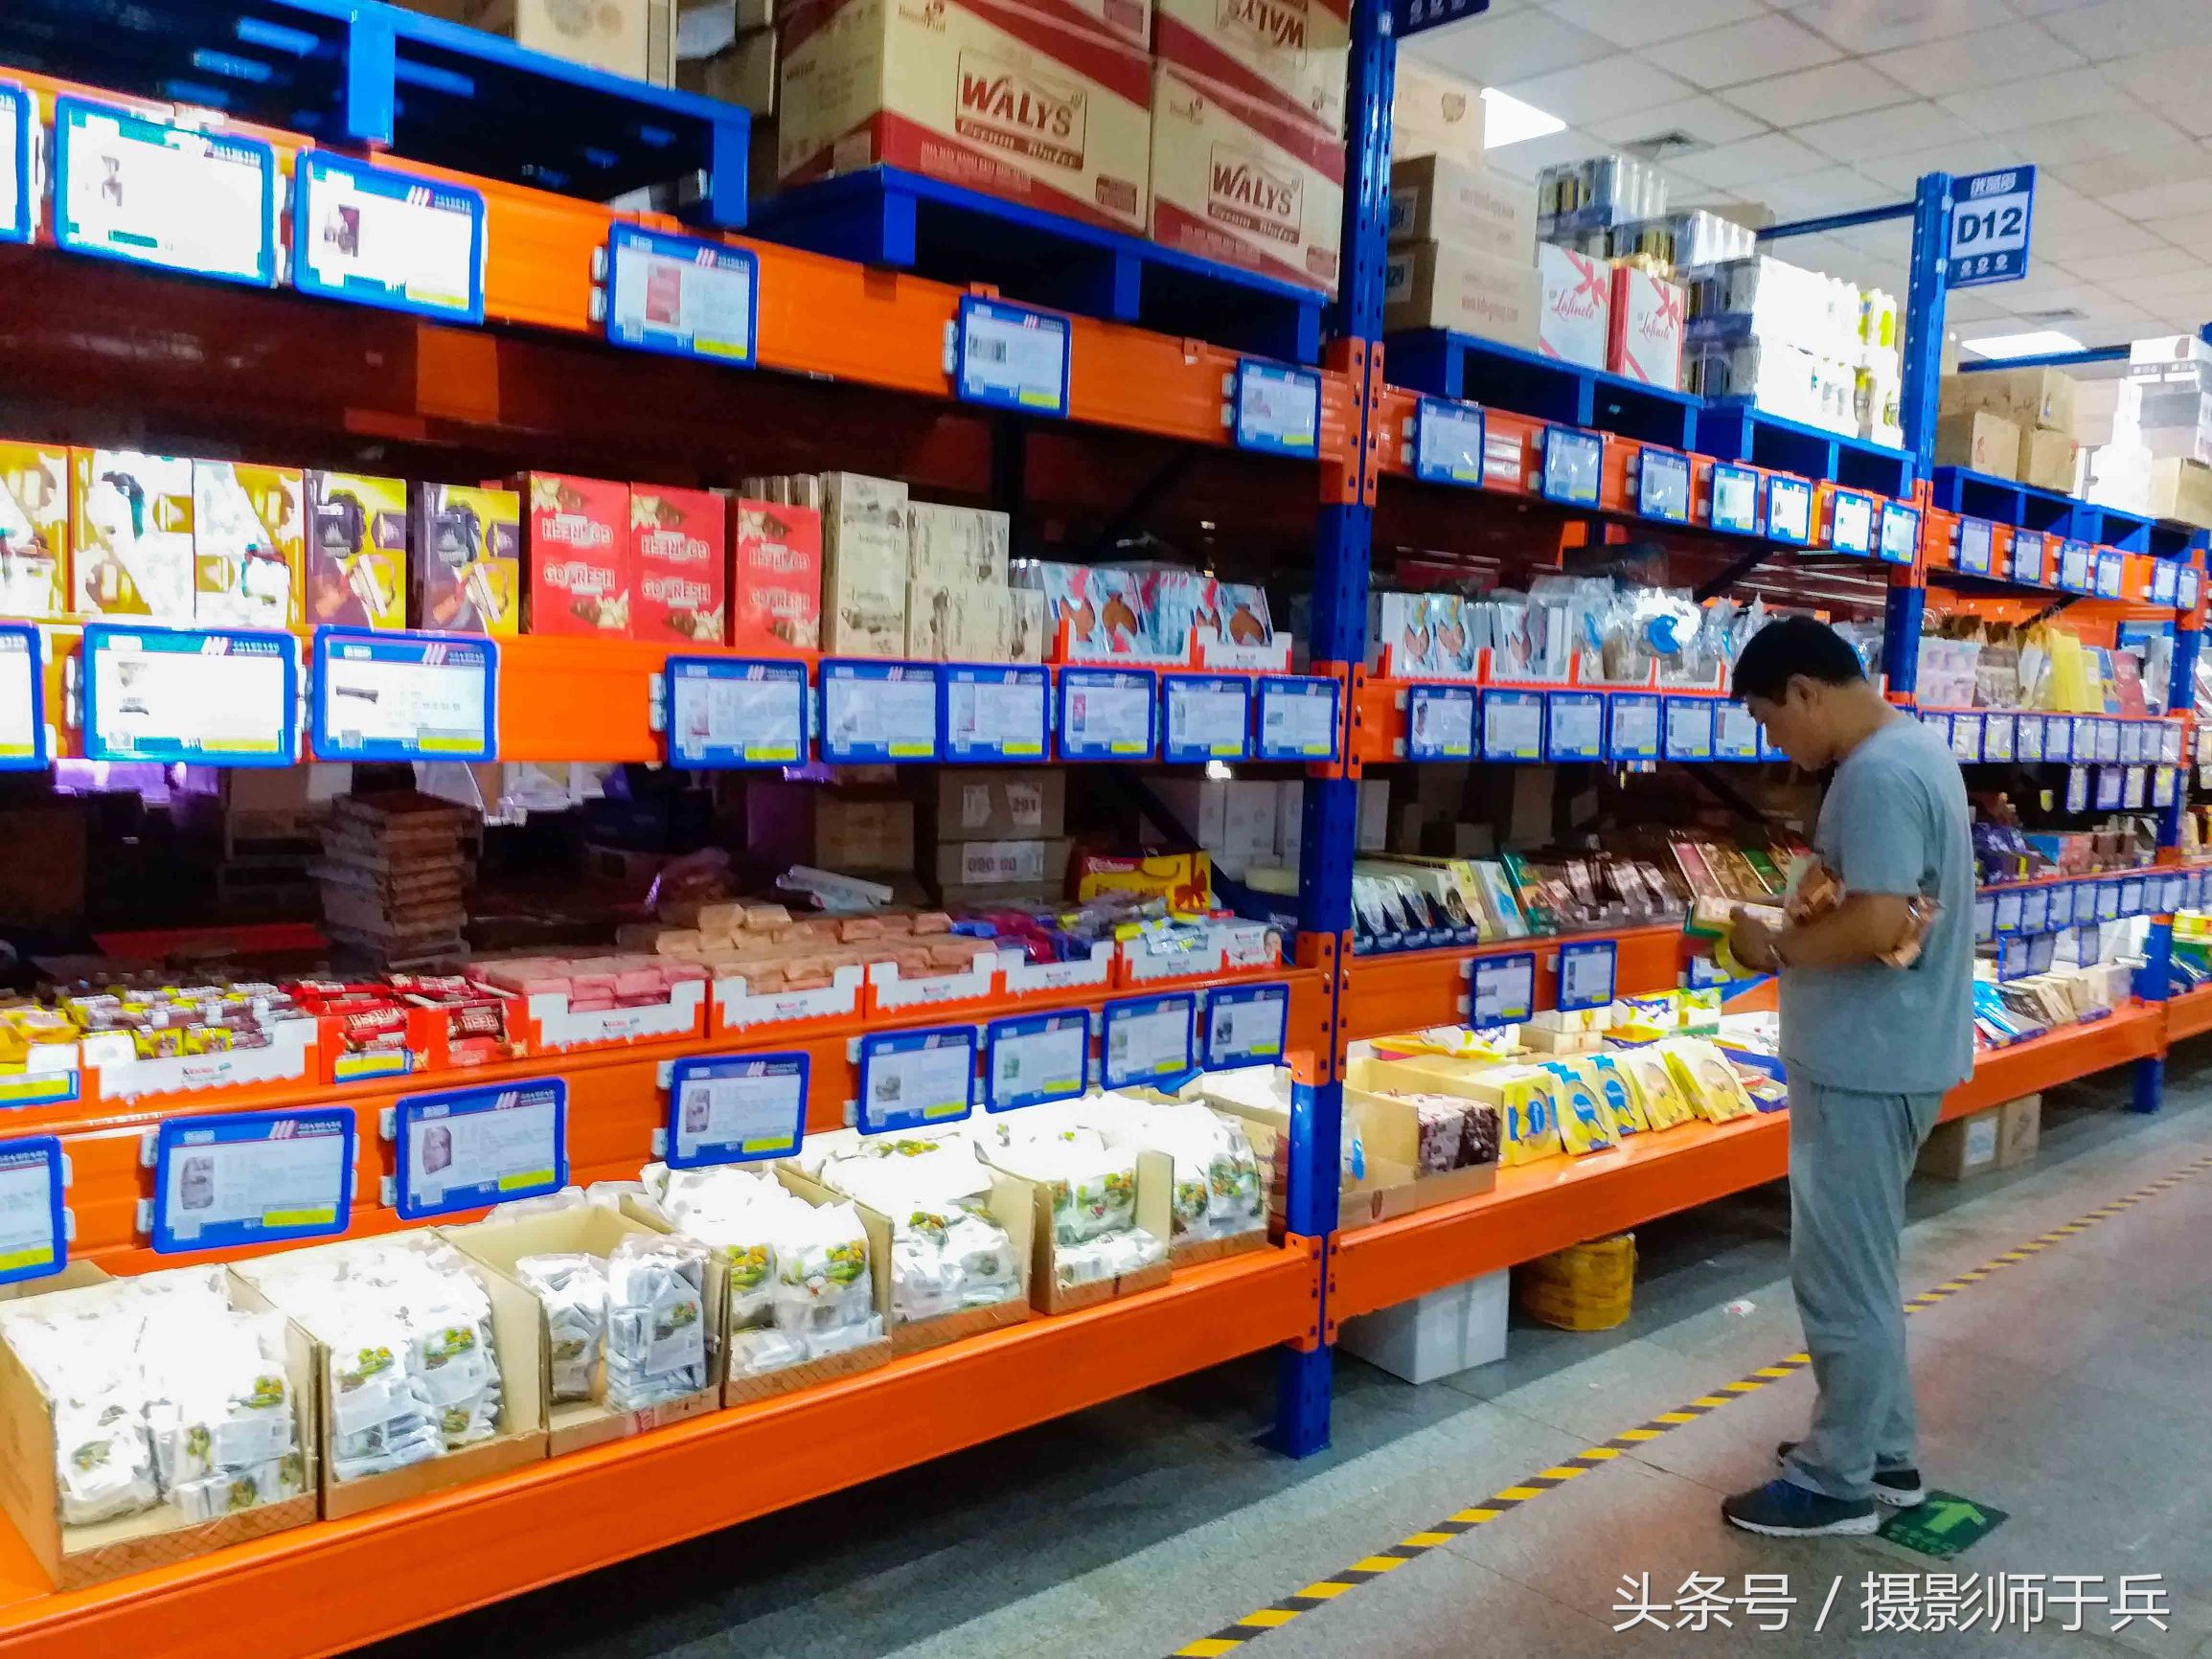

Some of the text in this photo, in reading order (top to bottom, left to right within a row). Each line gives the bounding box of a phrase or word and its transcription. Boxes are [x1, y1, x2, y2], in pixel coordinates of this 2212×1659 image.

[963, 71, 1073, 137] WALYS
[1212, 163, 1293, 216] WALYS
[1956, 207, 2022, 245] D12
